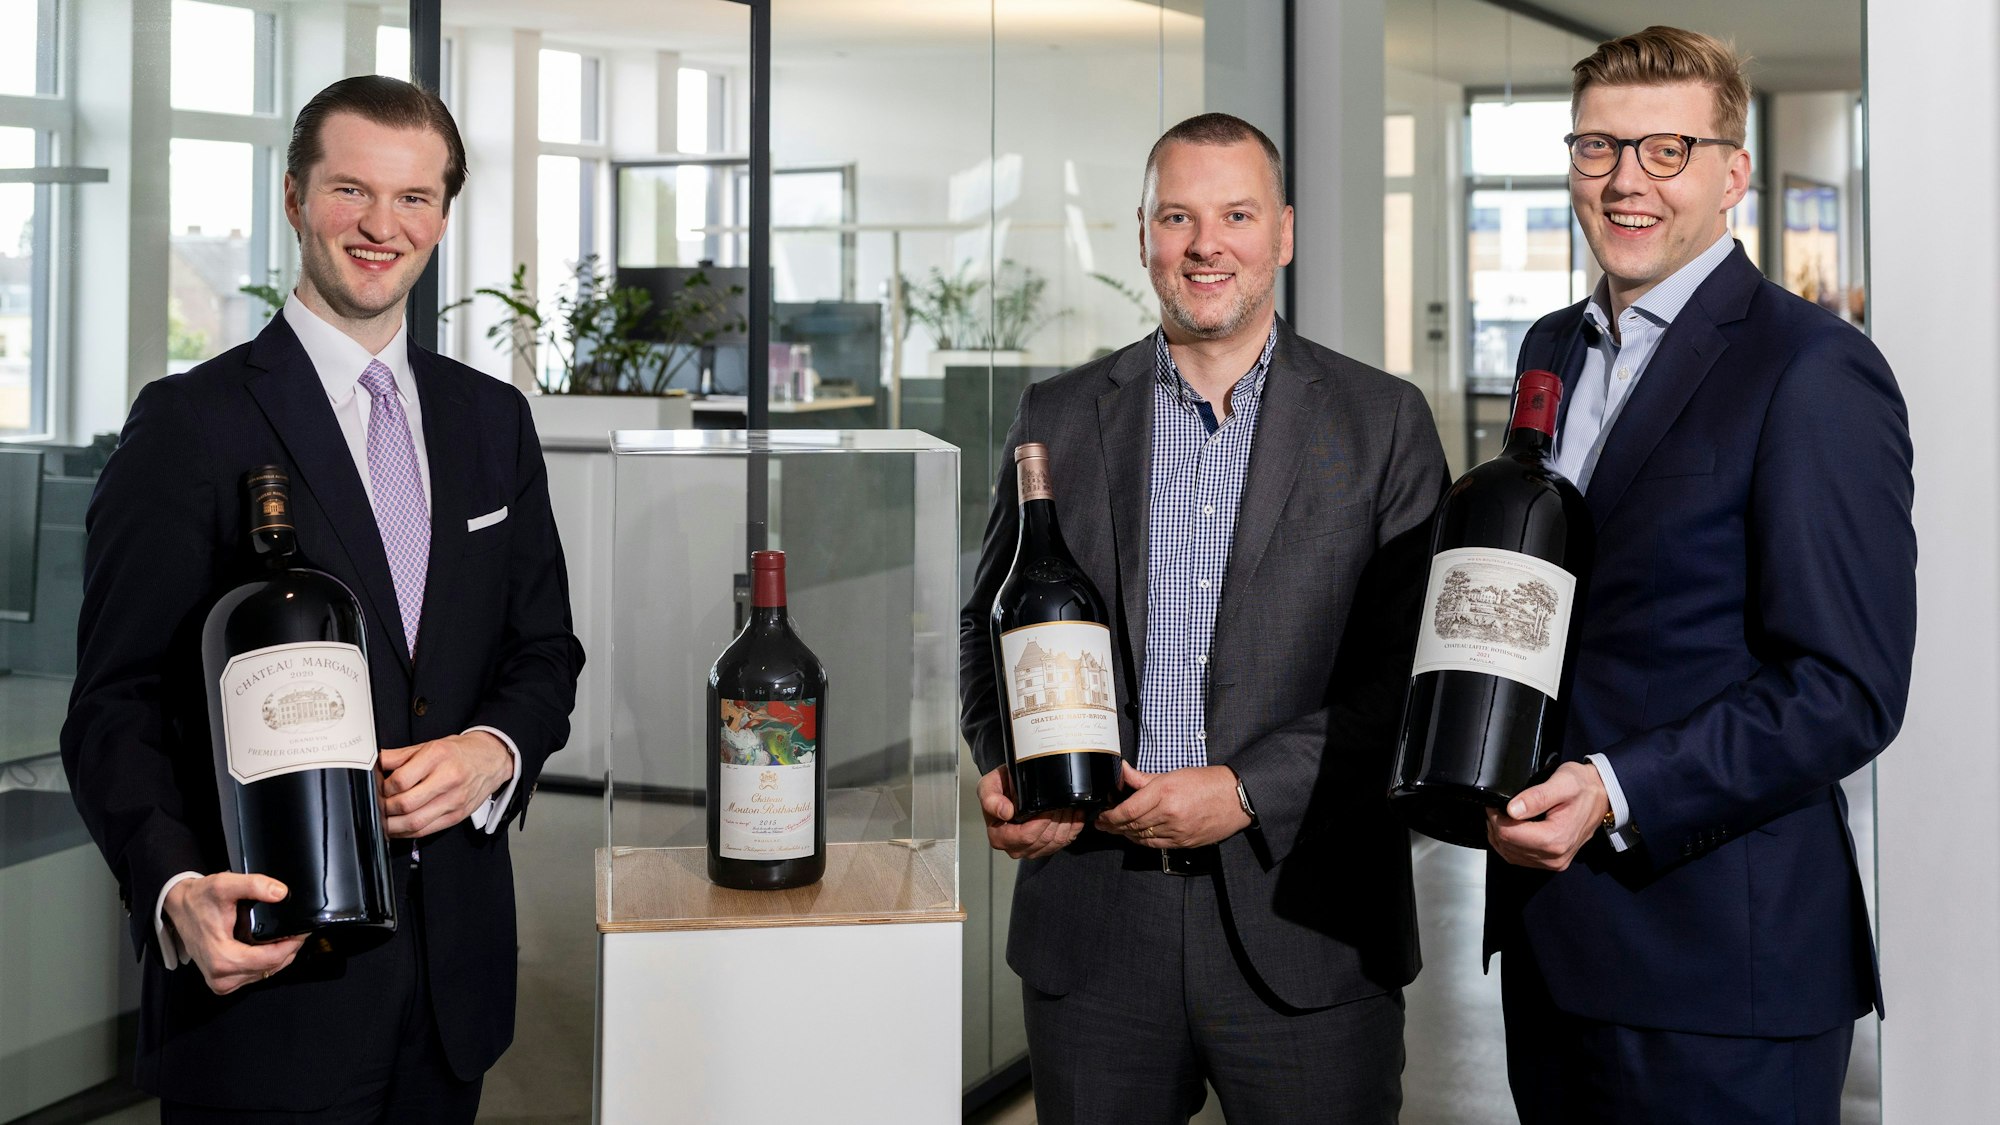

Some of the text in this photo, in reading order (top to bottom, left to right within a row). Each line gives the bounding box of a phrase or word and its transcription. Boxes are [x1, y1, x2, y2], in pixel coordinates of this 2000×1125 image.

[290, 670, 314, 679] 2020
[302, 657, 360, 683] MARGAUX
[247, 746, 286, 757] PREMIER
[286, 745, 319, 756] GRAND
[321, 743, 338, 752] CRU
[723, 801, 811, 814] Mouton Rothschild
